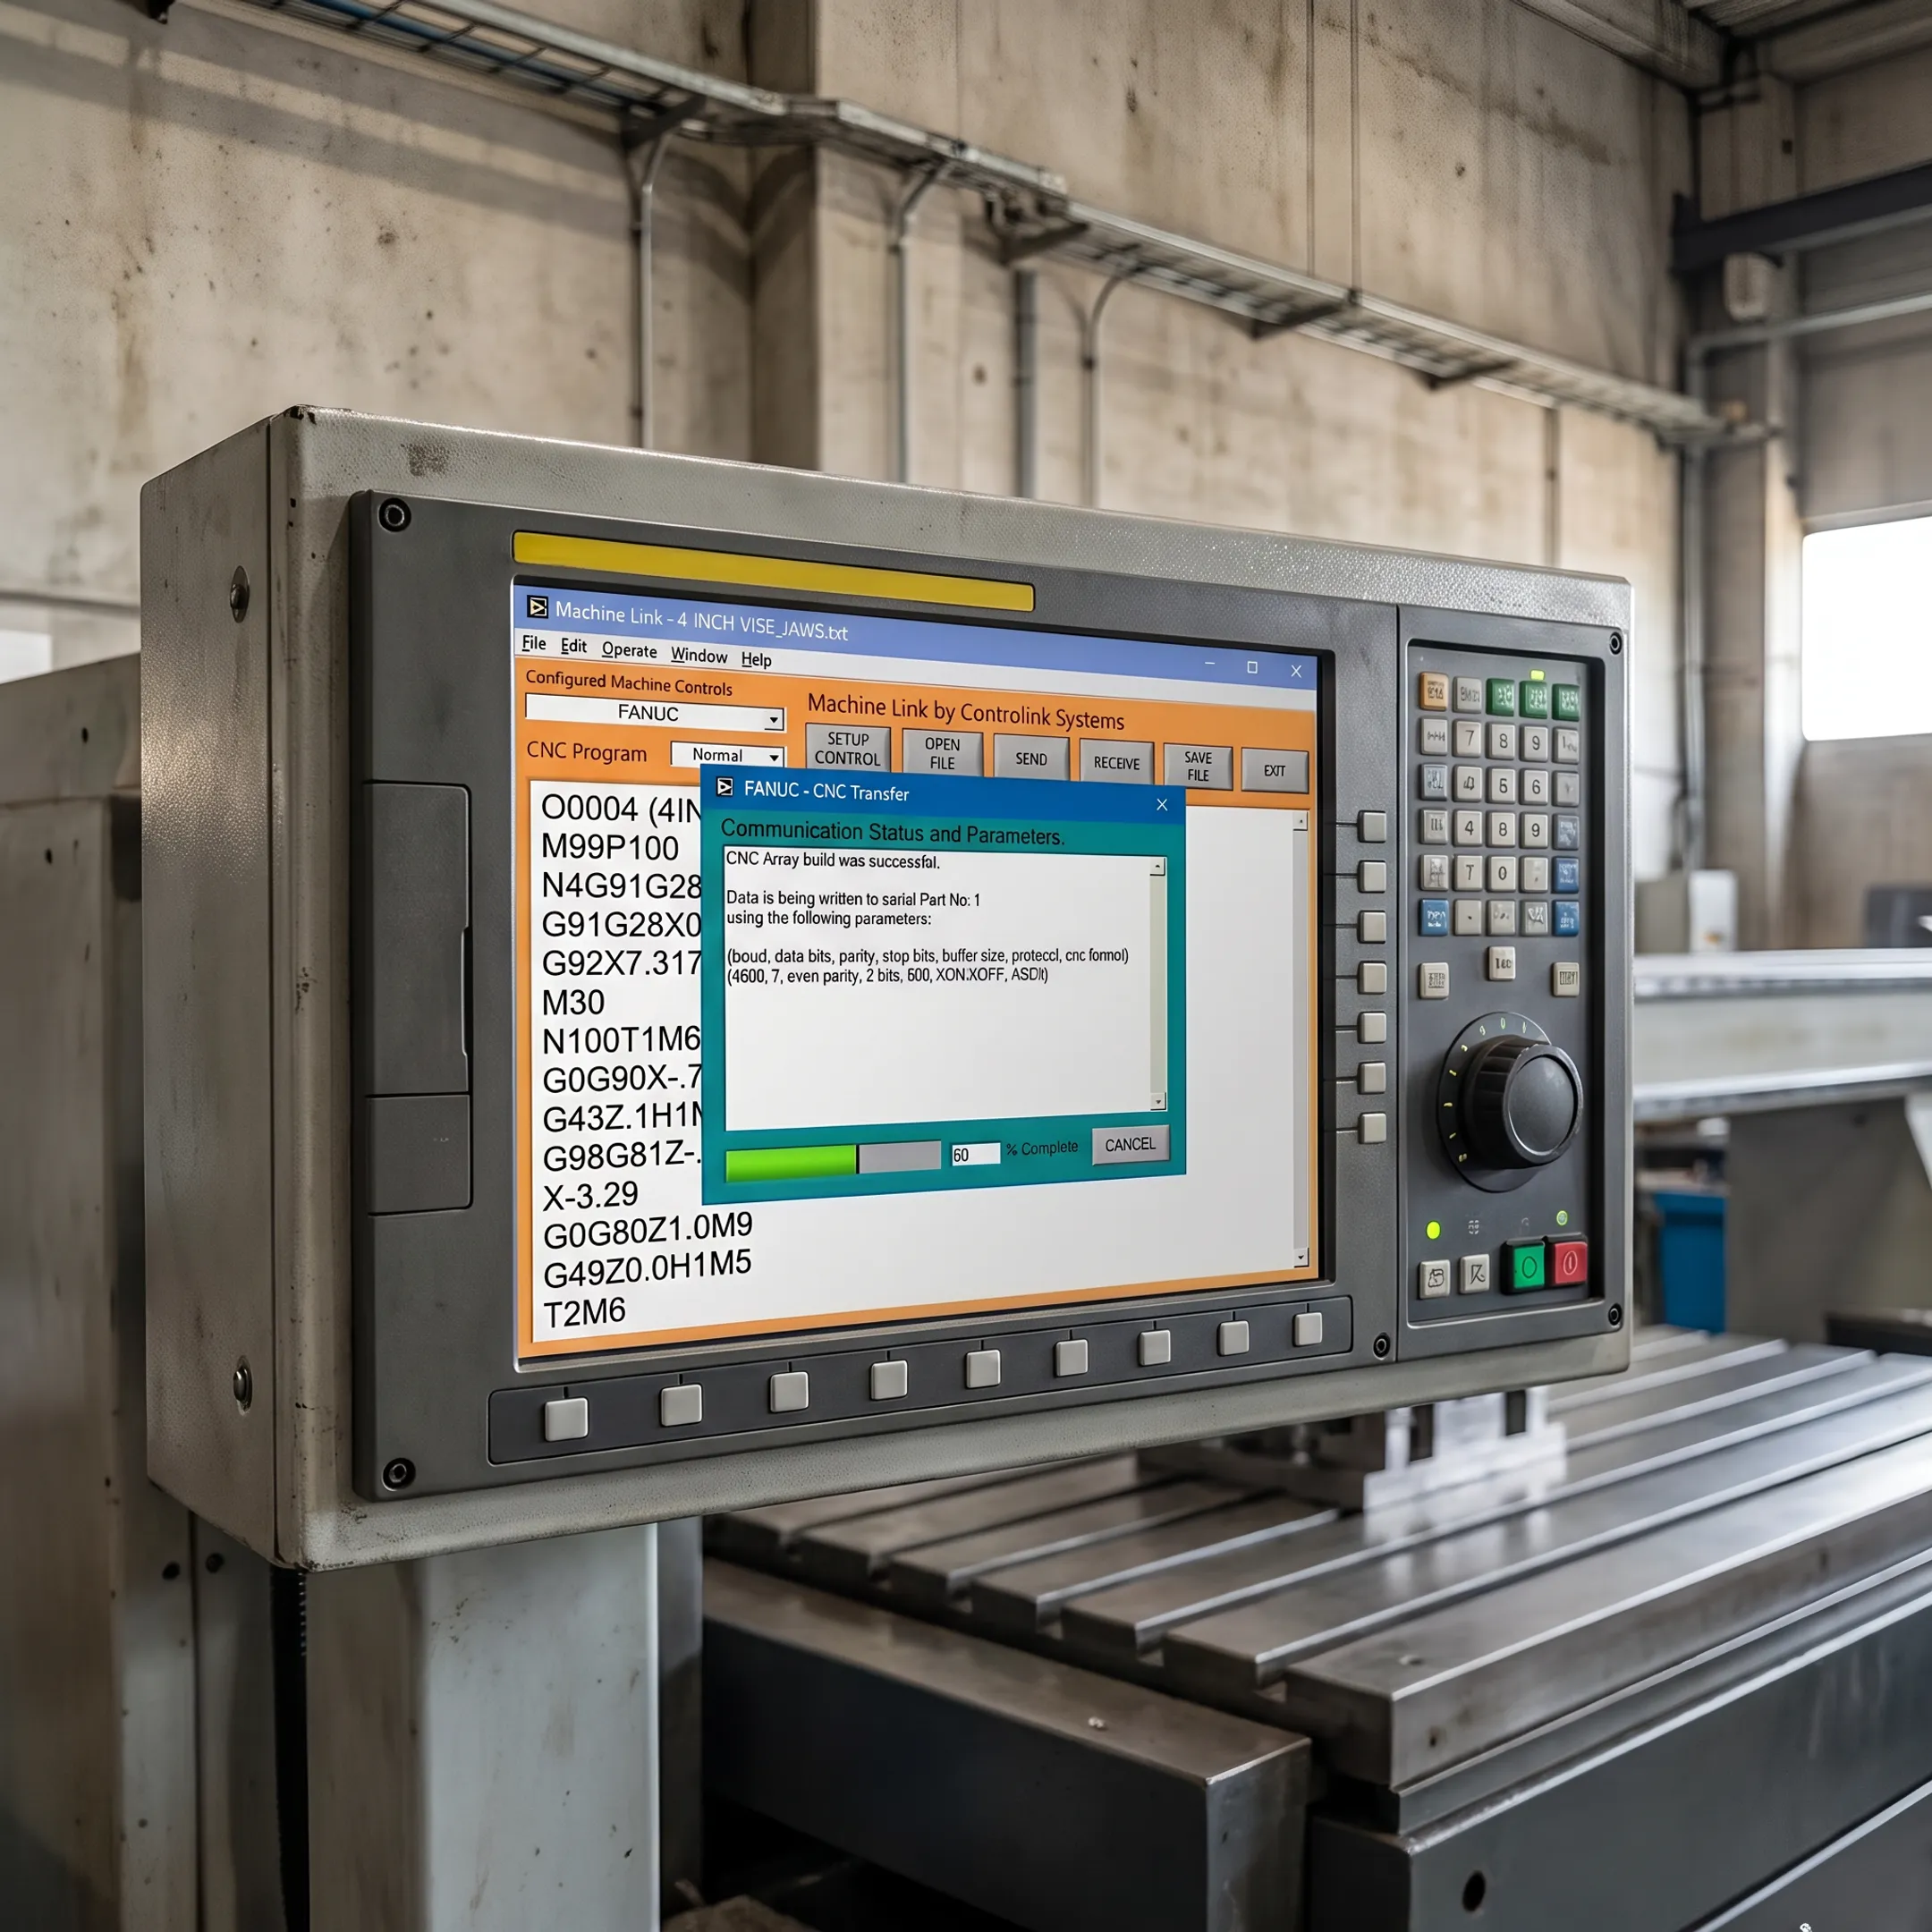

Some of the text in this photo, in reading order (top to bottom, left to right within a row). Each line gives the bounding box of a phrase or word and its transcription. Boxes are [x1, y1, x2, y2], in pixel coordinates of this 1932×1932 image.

[556, 601, 625, 623] Machine
[631, 608, 663, 626] Link
[677, 611, 688, 628] 4
[694, 613, 734, 631] INCH
[741, 617, 849, 641] VISE_JAWS.txt
[522, 635, 547, 652] File
[561, 638, 587, 655] Edit
[602, 641, 657, 660] Operate
[671, 646, 728, 664] Window
[741, 652, 772, 669] Help
[526, 669, 733, 697] Configured Machine Controls
[618, 703, 679, 722] FANUC
[808, 692, 1124, 733] Machine Link by Controlink Systems
[827, 731, 869, 747] SETUP
[925, 737, 961, 752] OPEN
[1464, 730, 1475, 747] 7
[1499, 733, 1508, 749] 8
[1531, 735, 1540, 750] 9
[527, 741, 648, 767] CNC Program
[692, 747, 743, 764] Normal
[815, 750, 881, 767] CONTROL
[930, 756, 955, 770] FILE
[1016, 752, 1047, 767] SEND
[1184, 751, 1212, 766] SAVE
[1094, 756, 1140, 771] RECEIVE
[1264, 764, 1285, 777] EXIT
[1188, 768, 1209, 783] FILE
[745, 780, 800, 798] FANUC
[813, 784, 846, 800] CNC
[851, 784, 910, 801] Transfer
[1531, 779, 1541, 794] 6
[721, 818, 1065, 846] Communication Status and Parameters.
[1464, 820, 1474, 835] 4
[1498, 822, 1508, 837] 8
[1531, 823, 1540, 837] 9
[542, 833, 679, 860] M99P100
[726, 851, 759, 866] CNC
[763, 852, 799, 869] Array
[803, 852, 835, 867] build
[839, 857, 865, 868] was
[543, 872, 701, 899] N4G91G28
[727, 890, 758, 905] Data
[763, 890, 774, 905] is
[778, 891, 815, 908] being
[819, 892, 862, 906] written
[867, 893, 878, 906] to
[920, 893, 945, 906] Part
[950, 894, 970, 906] No:
[974, 894, 980, 906] 1
[543, 911, 701, 936] G91G28X0
[727, 911, 932, 929] using the following parameters:
[543, 950, 701, 976] G92X7.317
[775, 949, 804, 962] data
[808, 948, 835, 965] bits,
[839, 948, 878, 966] parity,
[882, 949, 909, 966] stop
[913, 948, 938, 963] bits,
[943, 948, 978, 962] buffer
[980, 948, 1008, 963] size,
[1065, 951, 1086, 962] cnc
[727, 969, 768, 985] (4600,
[772, 969, 784, 985] 7,
[787, 972, 819, 983] even
[823, 969, 861, 986] parity,
[866, 969, 874, 982] 2
[877, 968, 903, 984] bits,
[543, 989, 605, 1015] M30
[543, 1025, 701, 1055] N100T1M6
[953, 1140, 1079, 1163] 60 % Complete
[1106, 1137, 1157, 1152] CANCEL
[542, 1180, 639, 1212] X-3.29
[544, 1211, 753, 1250] G0G80Z1.0M9
[544, 1249, 752, 1288] G49Z0.0H1M5
[543, 1296, 626, 1328] T2M6
